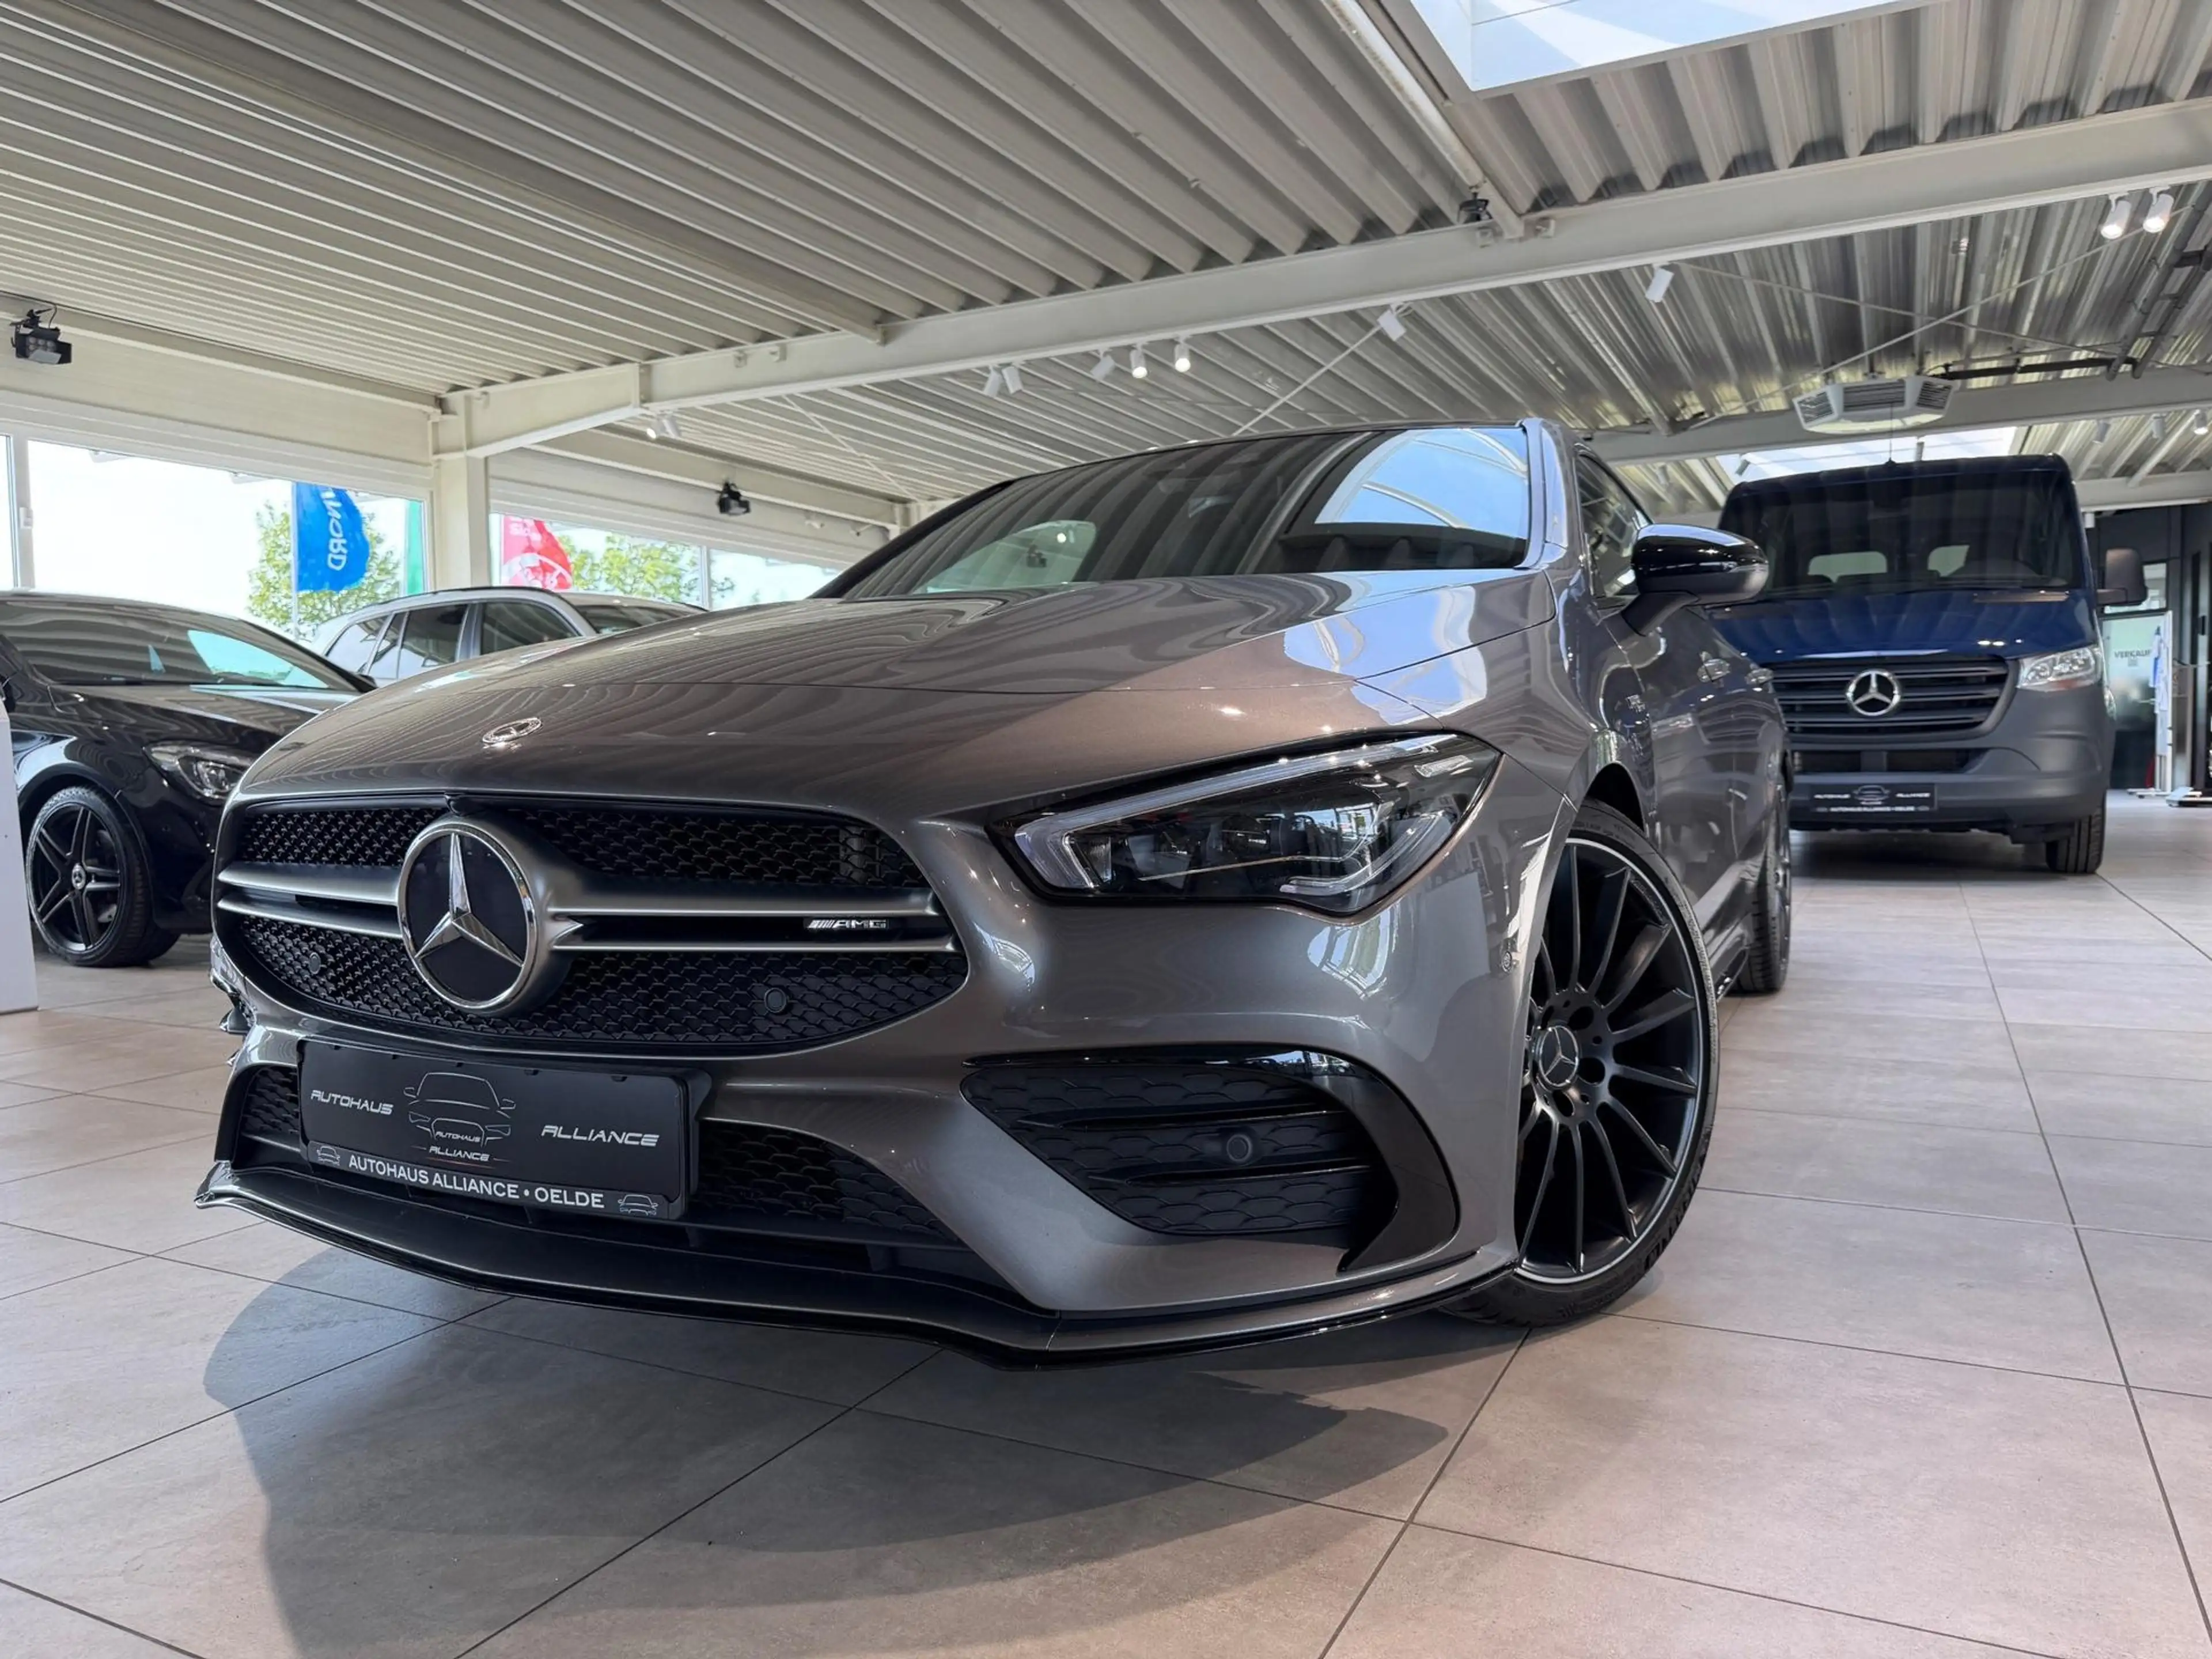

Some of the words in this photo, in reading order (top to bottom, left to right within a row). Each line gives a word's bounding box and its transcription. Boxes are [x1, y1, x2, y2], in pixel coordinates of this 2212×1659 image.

[832, 919, 887, 929] AMG
[310, 1089, 394, 1115] AUTOHAUS
[435, 1130, 481, 1142] AUTOHAUS
[541, 1124, 660, 1147] ALLIANCE
[429, 1146, 490, 1161] ALLIANCE
[349, 1154, 429, 1184] AUTOHAUS
[432, 1172, 520, 1198] ALLIANCE
[534, 1187, 605, 1208] OELDE
